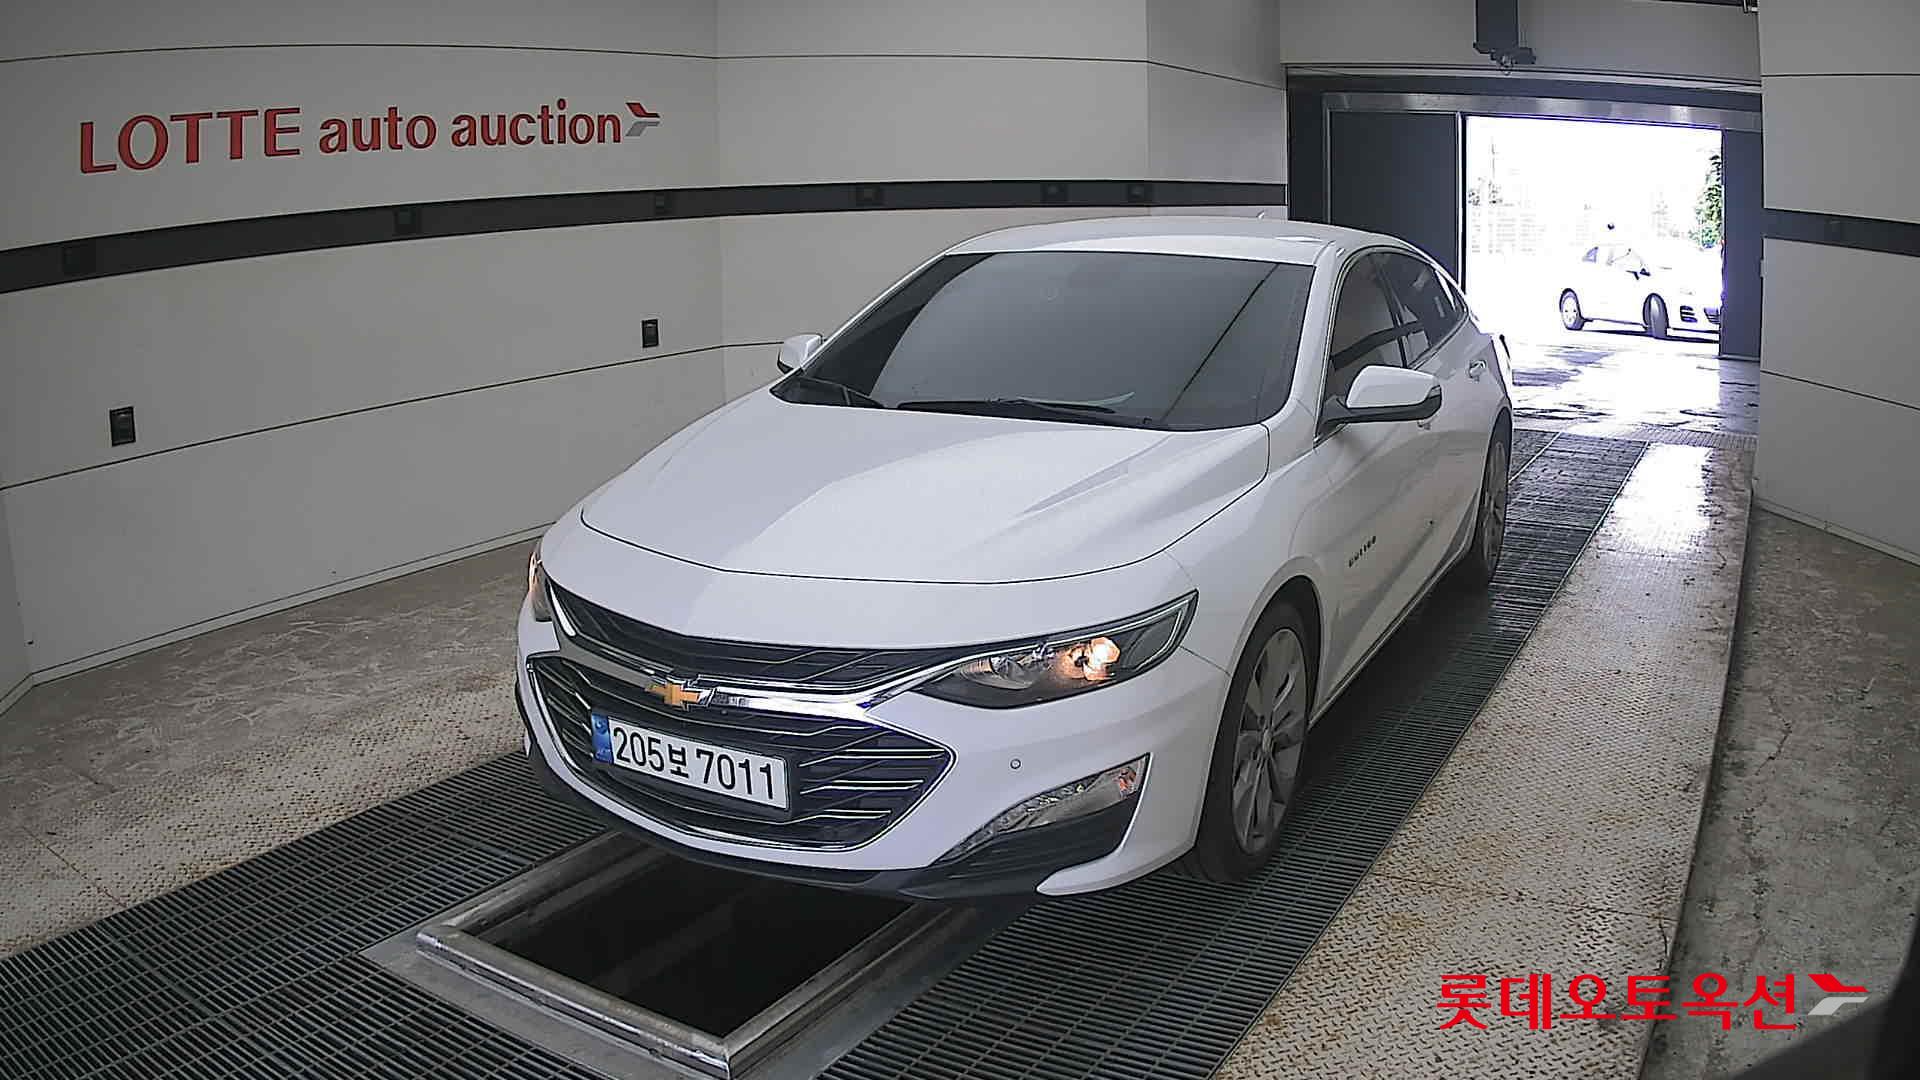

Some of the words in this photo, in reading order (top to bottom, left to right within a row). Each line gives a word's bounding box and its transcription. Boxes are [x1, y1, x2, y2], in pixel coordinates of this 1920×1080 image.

[79, 106, 301, 174] LOTTE
[318, 106, 437, 154] auto
[450, 98, 622, 147] auction
[613, 726, 690, 779] 205보
[696, 748, 774, 800] 7011
